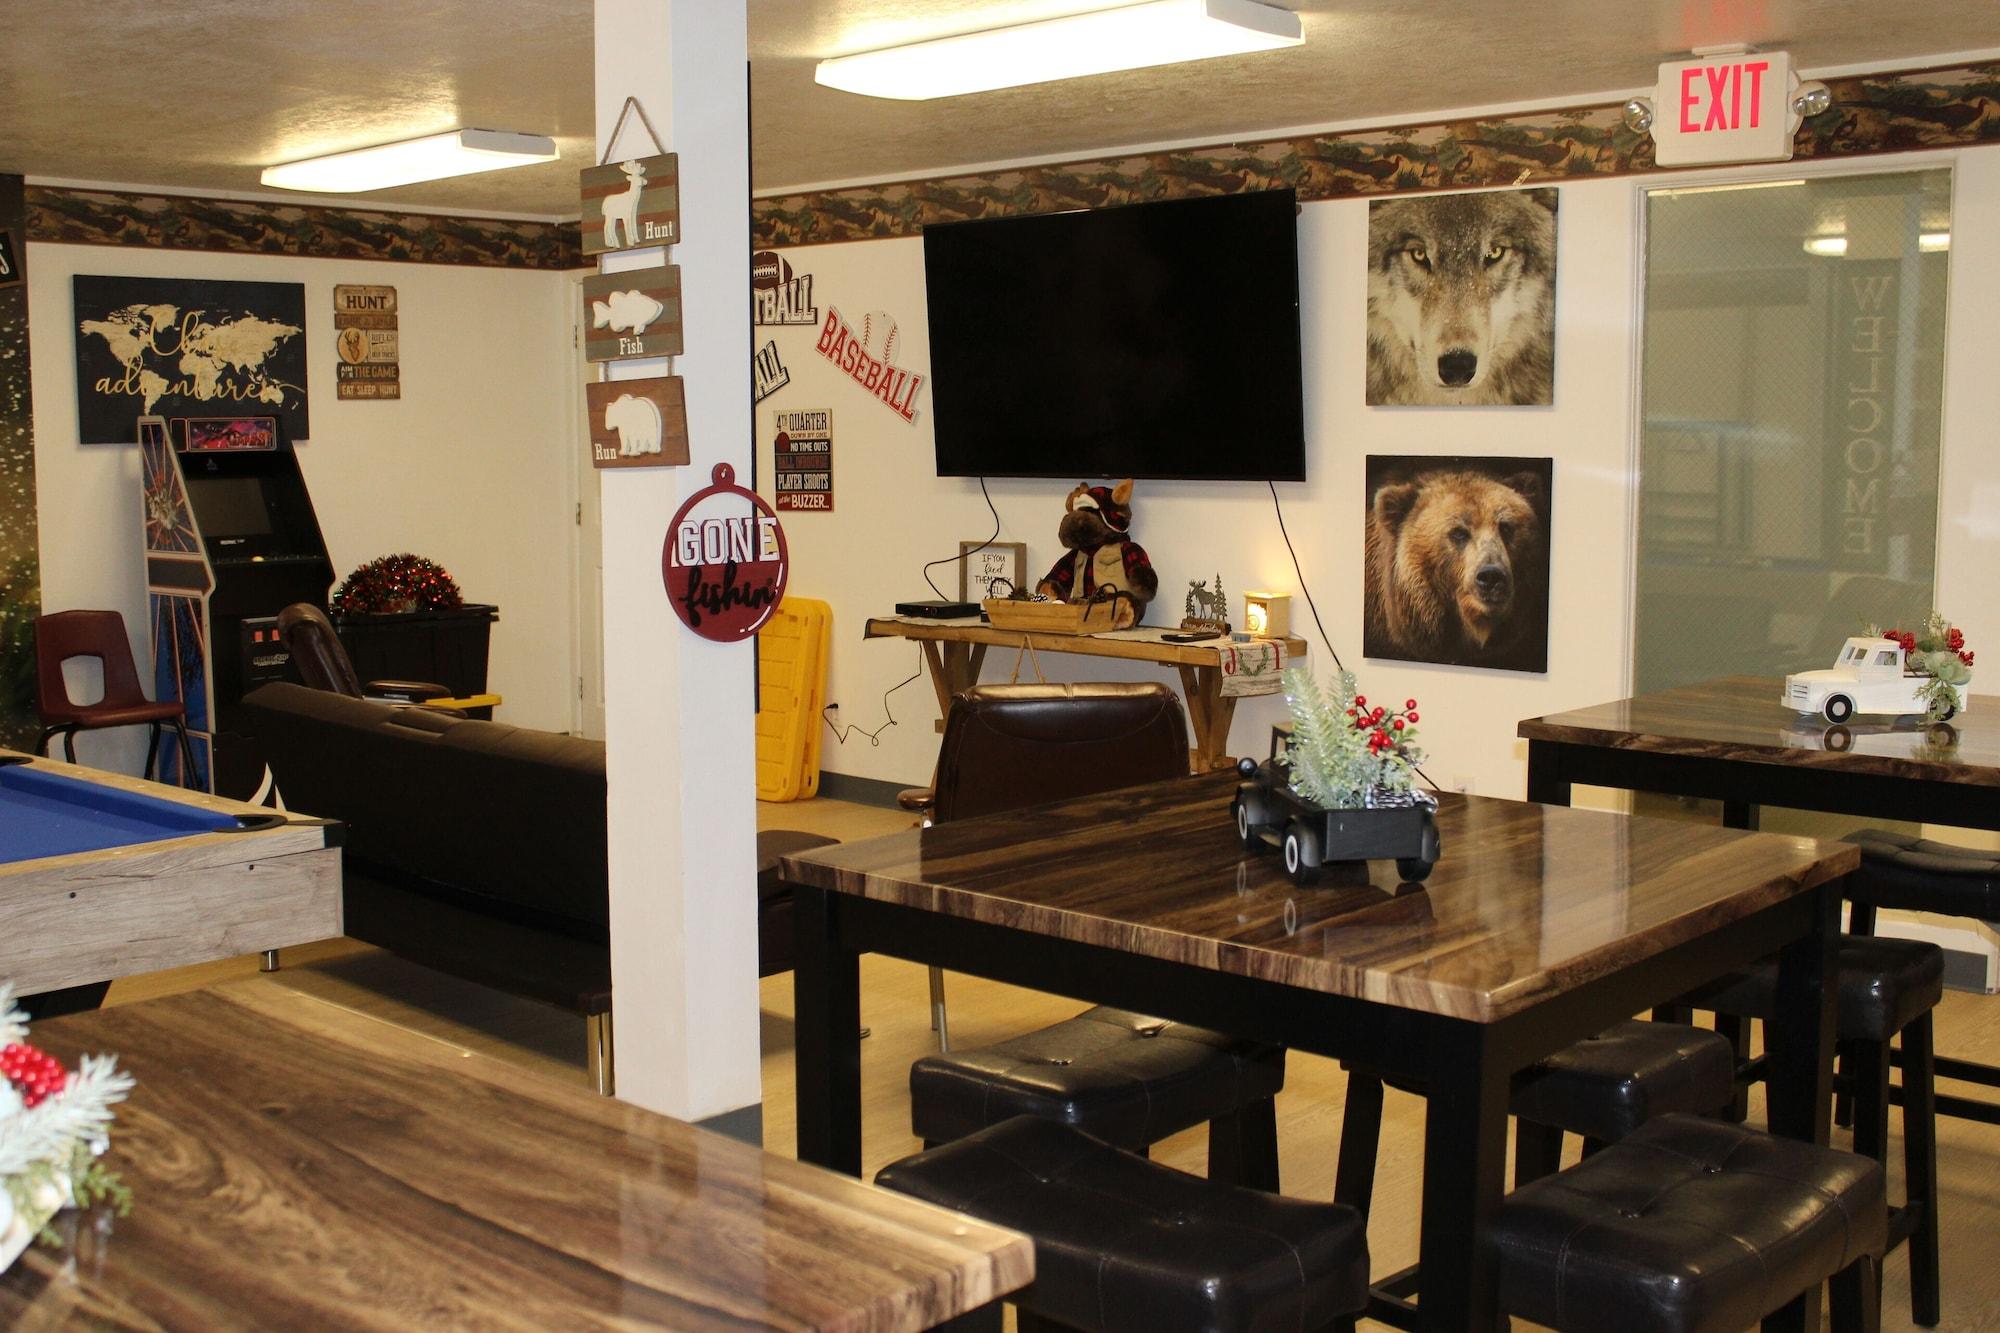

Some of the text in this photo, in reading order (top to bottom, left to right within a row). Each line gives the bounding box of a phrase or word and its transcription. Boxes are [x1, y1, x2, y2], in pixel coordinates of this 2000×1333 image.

[1680, 61, 1769, 134] EXIT
[645, 220, 673, 240] Hunt
[346, 295, 387, 310] HUNT
[754, 274, 817, 325] TBALL
[619, 337, 644, 356] Fish
[355, 366, 396, 378] THE GAME
[816, 305, 924, 424] BASEBALL
[341, 384, 397, 396] EAT SLEEP HUNT
[776, 412, 827, 431] 4TH QUARTER
[595, 443, 617, 461] Run
[790, 441, 828, 452] NO TIME OUTS
[778, 473, 829, 490] PLAYER SHOOTS
[678, 516, 780, 567] GONE
[982, 553, 1006, 563] IF YOU
[975, 575, 993, 585] THEM
